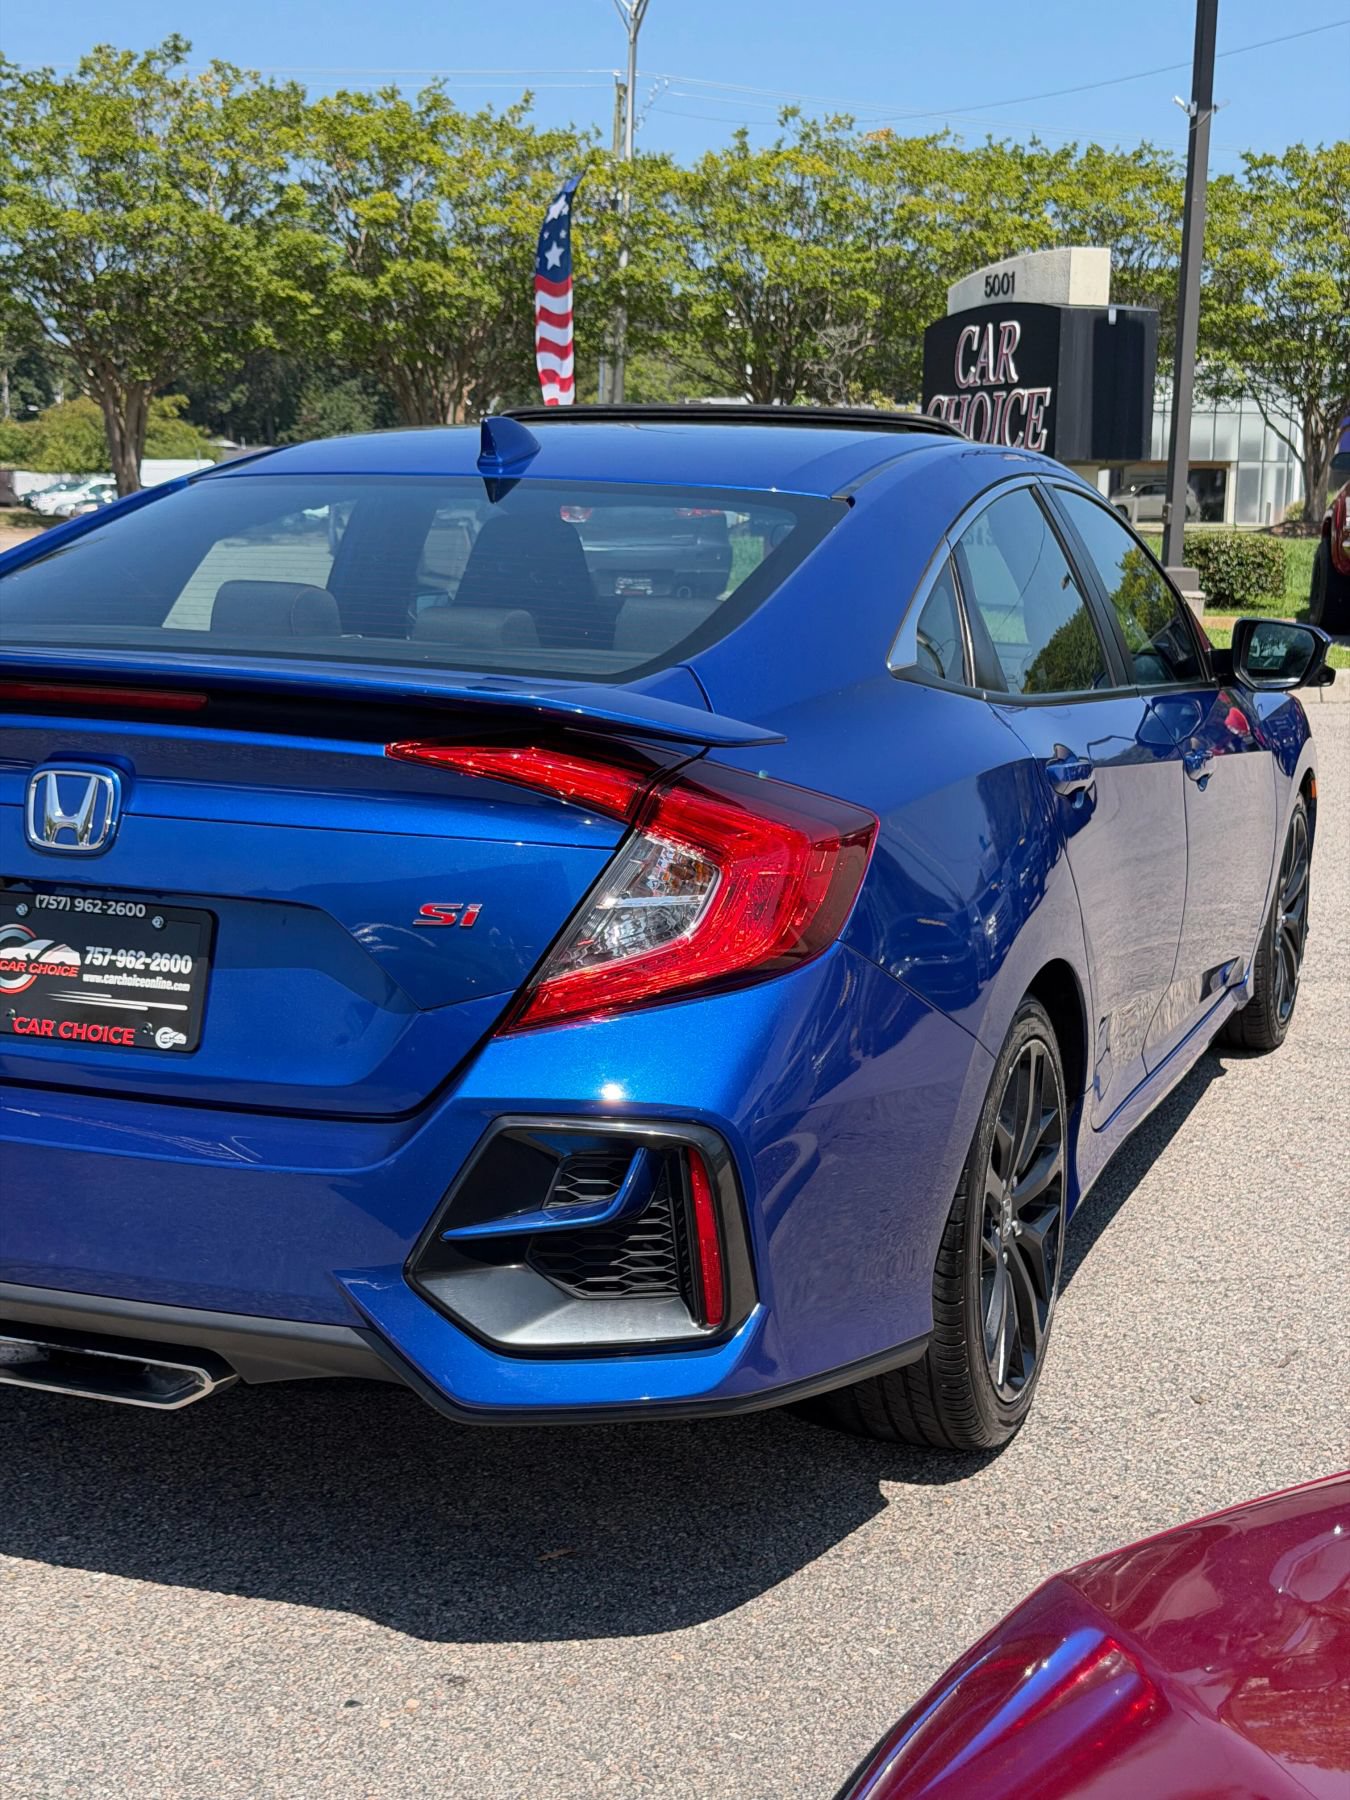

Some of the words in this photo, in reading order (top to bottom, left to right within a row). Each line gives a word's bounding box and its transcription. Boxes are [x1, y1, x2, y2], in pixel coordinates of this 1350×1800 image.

[984, 271, 1016, 298] 5001
[954, 320, 1021, 389] CAR
[35, 894, 71, 911] (757)
[74, 898, 146, 918] 962-2600
[0, 960, 27, 973] CAR
[29, 962, 80, 978] CHOICE
[84, 946, 193, 975] 757-962-2600
[82, 972, 191, 993] www.carchoiceonline.com
[13, 1016, 55, 1037] CAR
[58, 1021, 136, 1046] CHOICE
